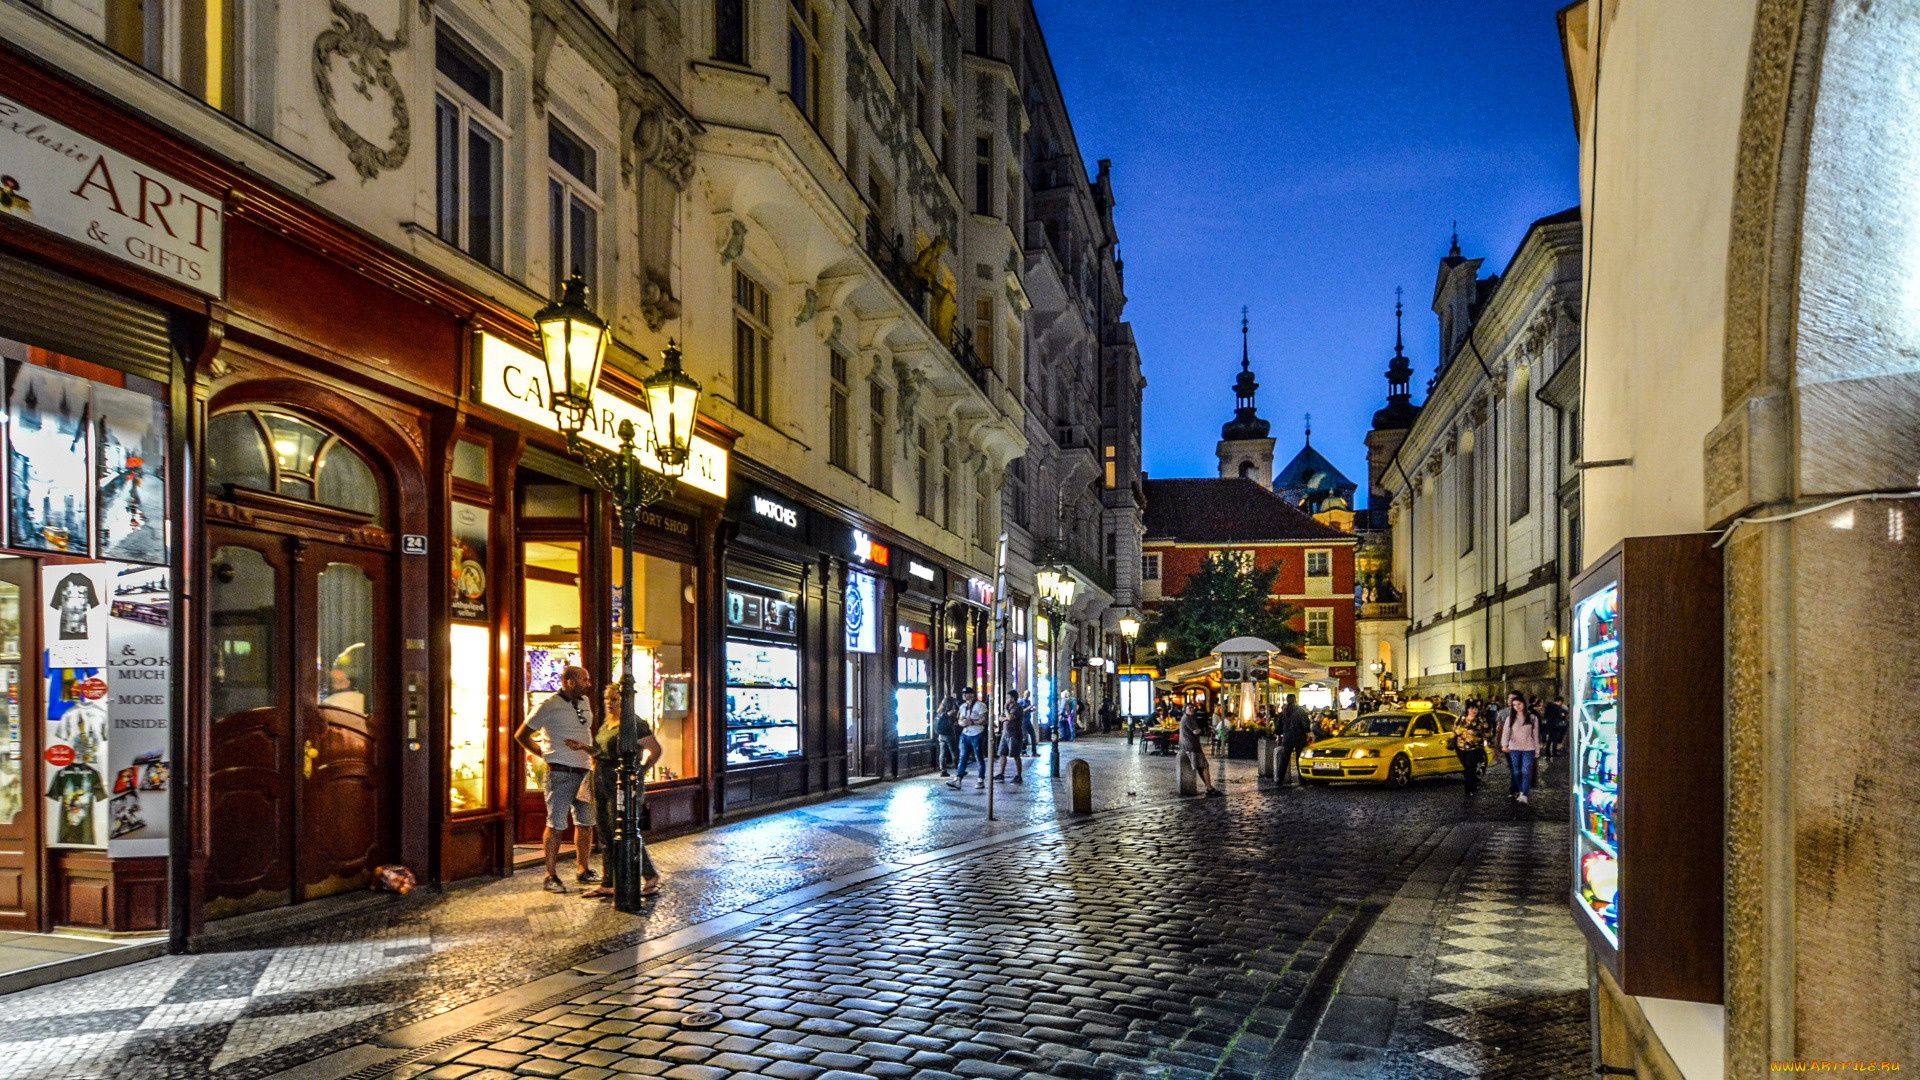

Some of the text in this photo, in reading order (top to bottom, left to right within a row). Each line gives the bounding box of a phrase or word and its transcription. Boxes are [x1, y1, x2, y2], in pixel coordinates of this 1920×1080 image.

[70, 154, 219, 252] ART
[87, 220, 201, 281] & GIFTS
[753, 495, 797, 528] WATCHES
[664, 517, 689, 535] SHOP
[406, 537, 422, 547] 24
[121, 644, 136, 656] &
[118, 669, 165, 680] MUCH
[117, 694, 165, 705] MORE
[115, 718, 168, 729] INSIDE
